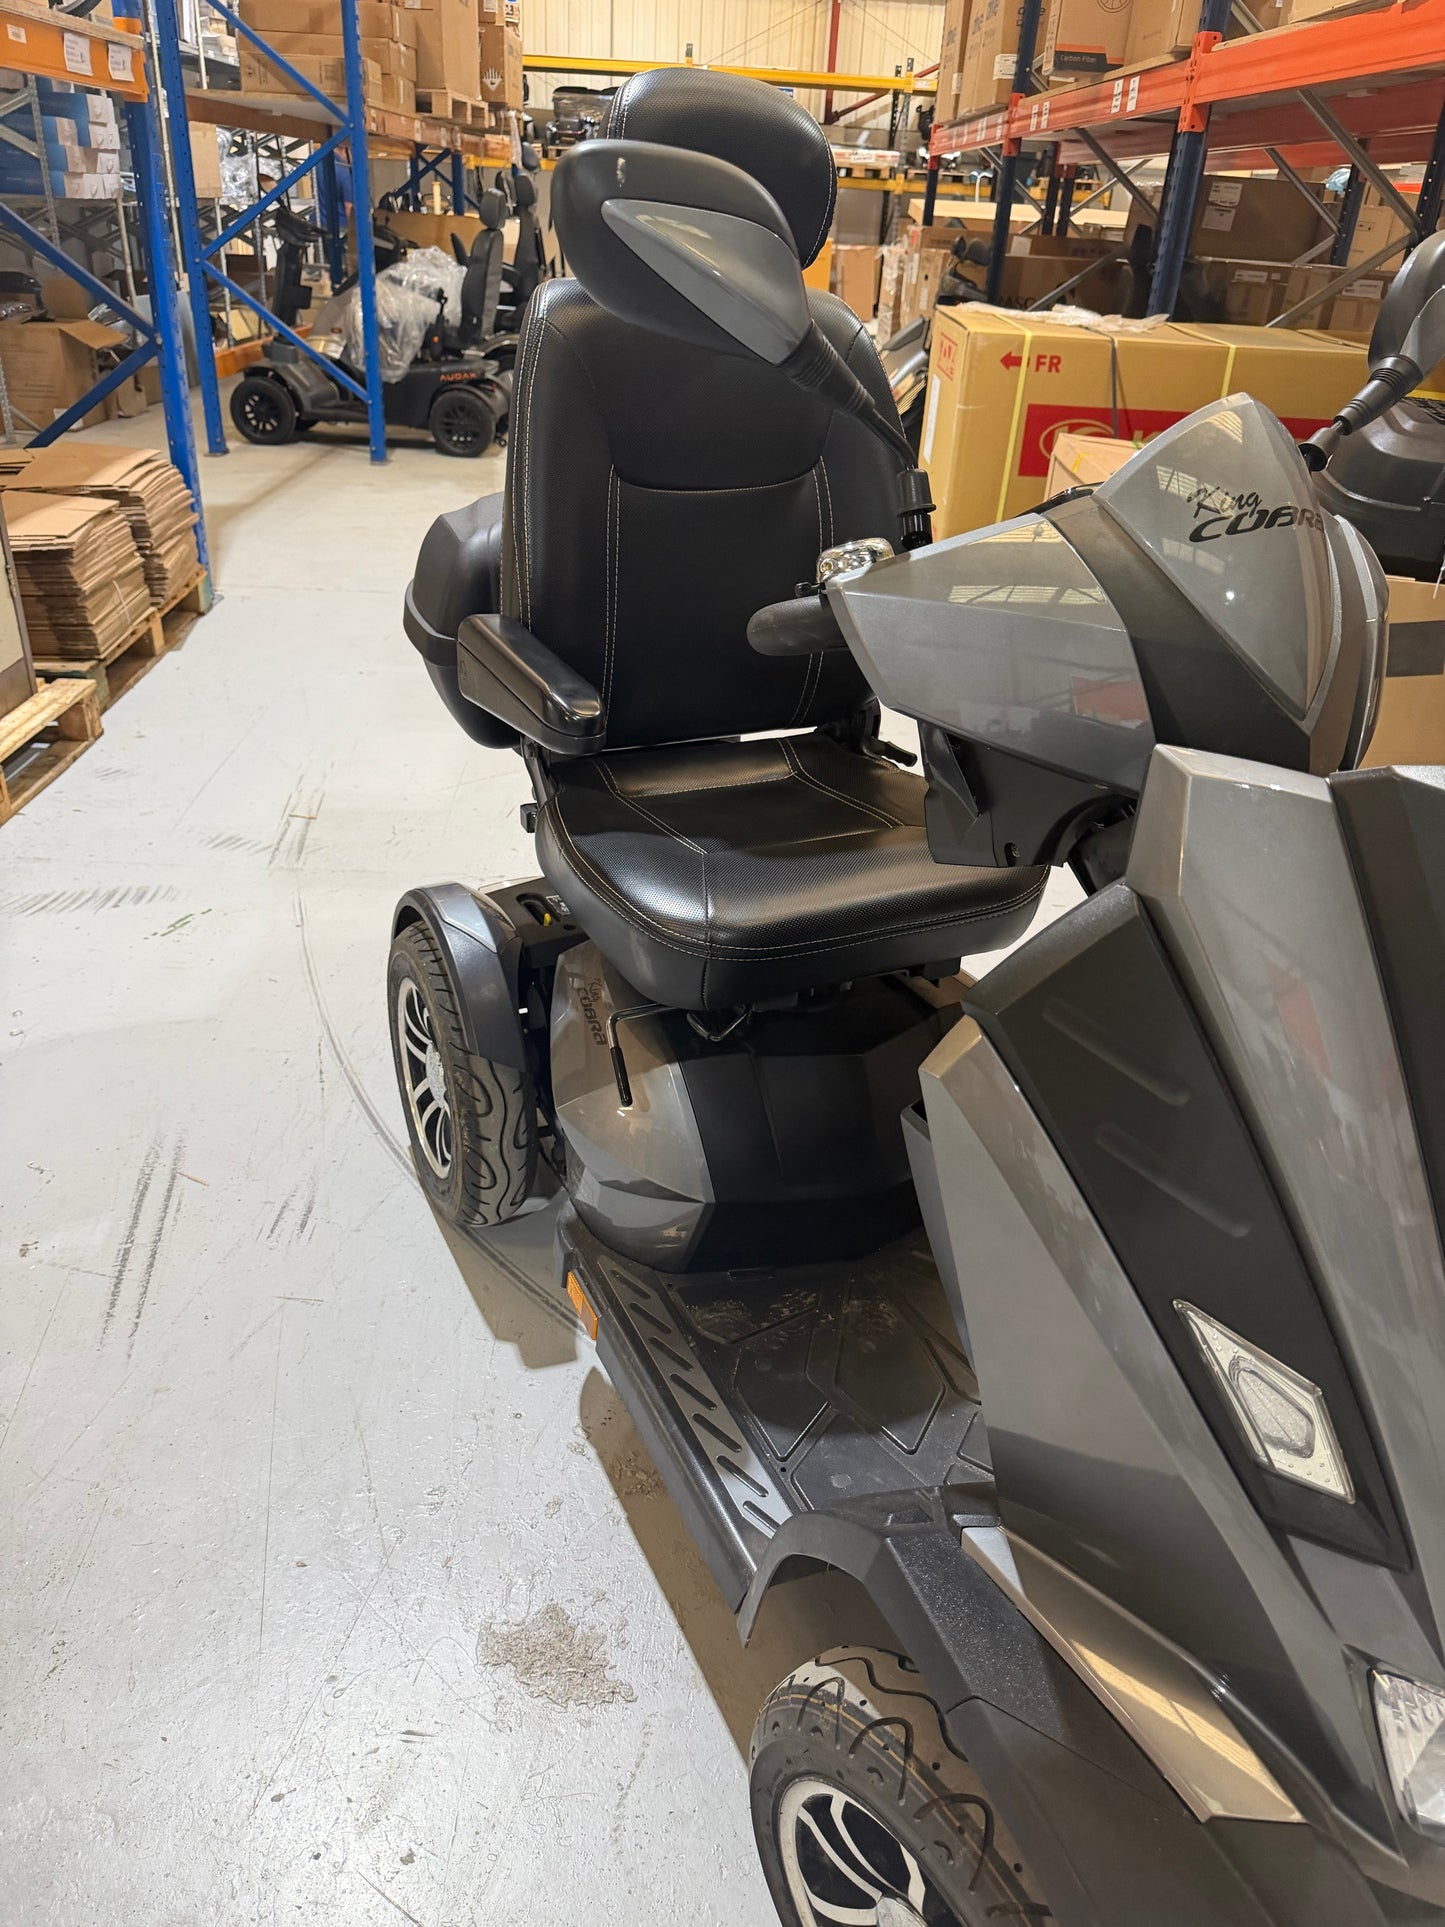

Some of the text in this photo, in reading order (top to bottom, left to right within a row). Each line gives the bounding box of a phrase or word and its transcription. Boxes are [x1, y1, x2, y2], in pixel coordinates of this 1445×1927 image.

[1035, 354, 1062, 373] FR
[1187, 486, 1263, 518] King
[577, 987, 608, 1046] COBRA
